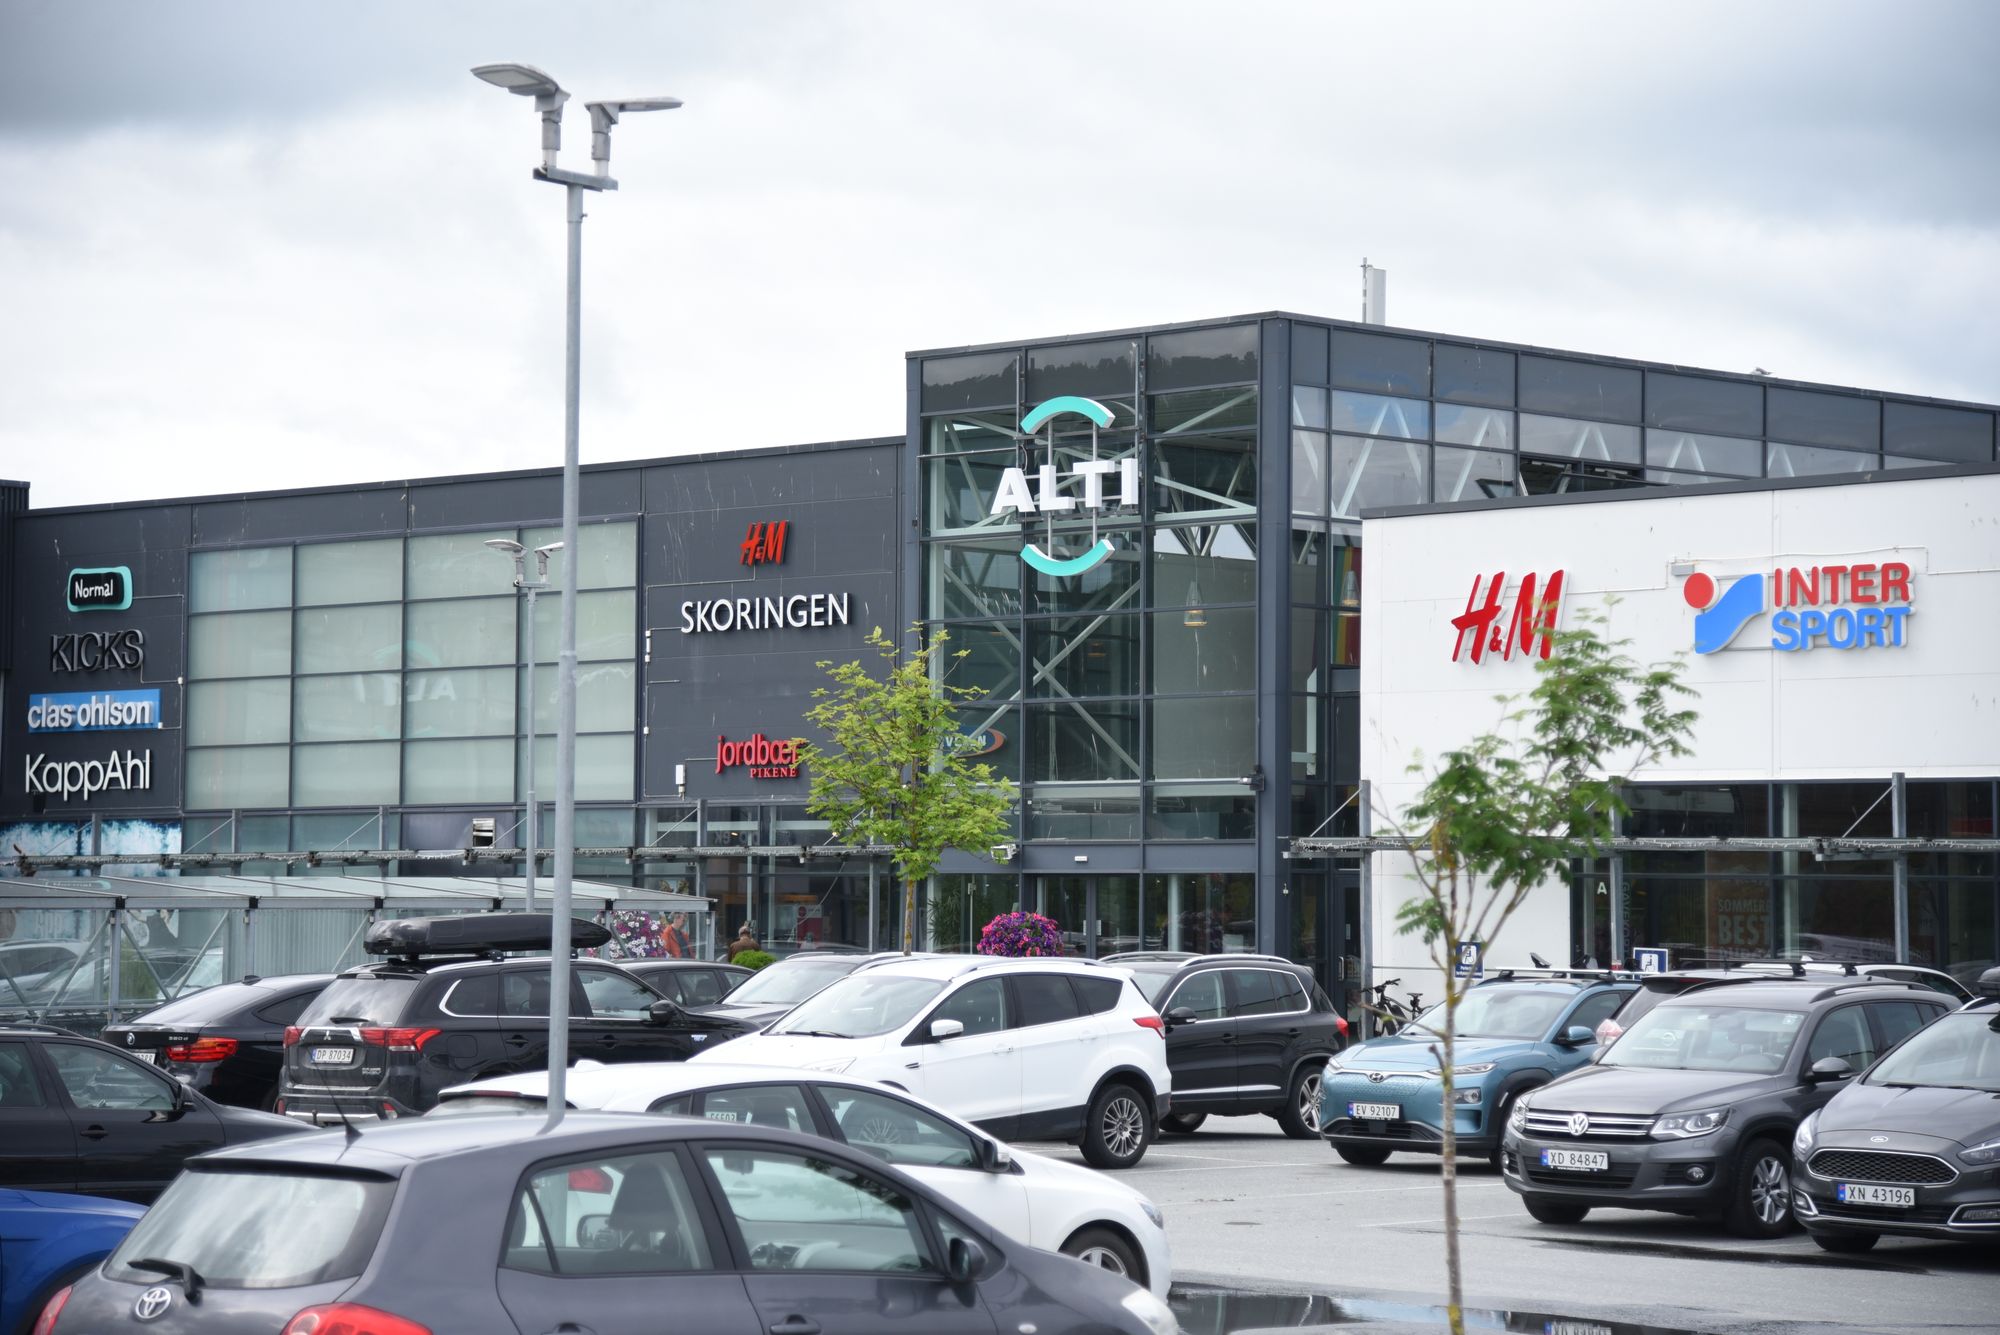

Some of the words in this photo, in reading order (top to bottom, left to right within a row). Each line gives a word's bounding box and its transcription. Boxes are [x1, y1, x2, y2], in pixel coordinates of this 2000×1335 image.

[990, 458, 1139, 515] ALTI
[739, 520, 788, 566] H&M
[74, 578, 114, 599] Normal
[1774, 562, 1911, 607] INTER
[681, 592, 849, 634] SKORINGEN
[1451, 569, 1566, 665] H&M
[1771, 606, 1912, 652] SPORT
[51, 628, 144, 673] KICKS
[27, 697, 73, 729] clas
[77, 694, 154, 727] ohlson
[25, 748, 151, 801] KappAhl
[750, 767, 798, 779] PIKENE
[316, 1050, 327, 1060] DP
[328, 1050, 351, 1060] 87034
[1356, 1105, 1367, 1115] EV
[1370, 1105, 1396, 1117] 92107
[1550, 1152, 1565, 1165] XD
[1569, 1153, 1605, 1167] 84847
[1848, 1186, 1866, 1200] XN
[1871, 1188, 1911, 1204] 43196
